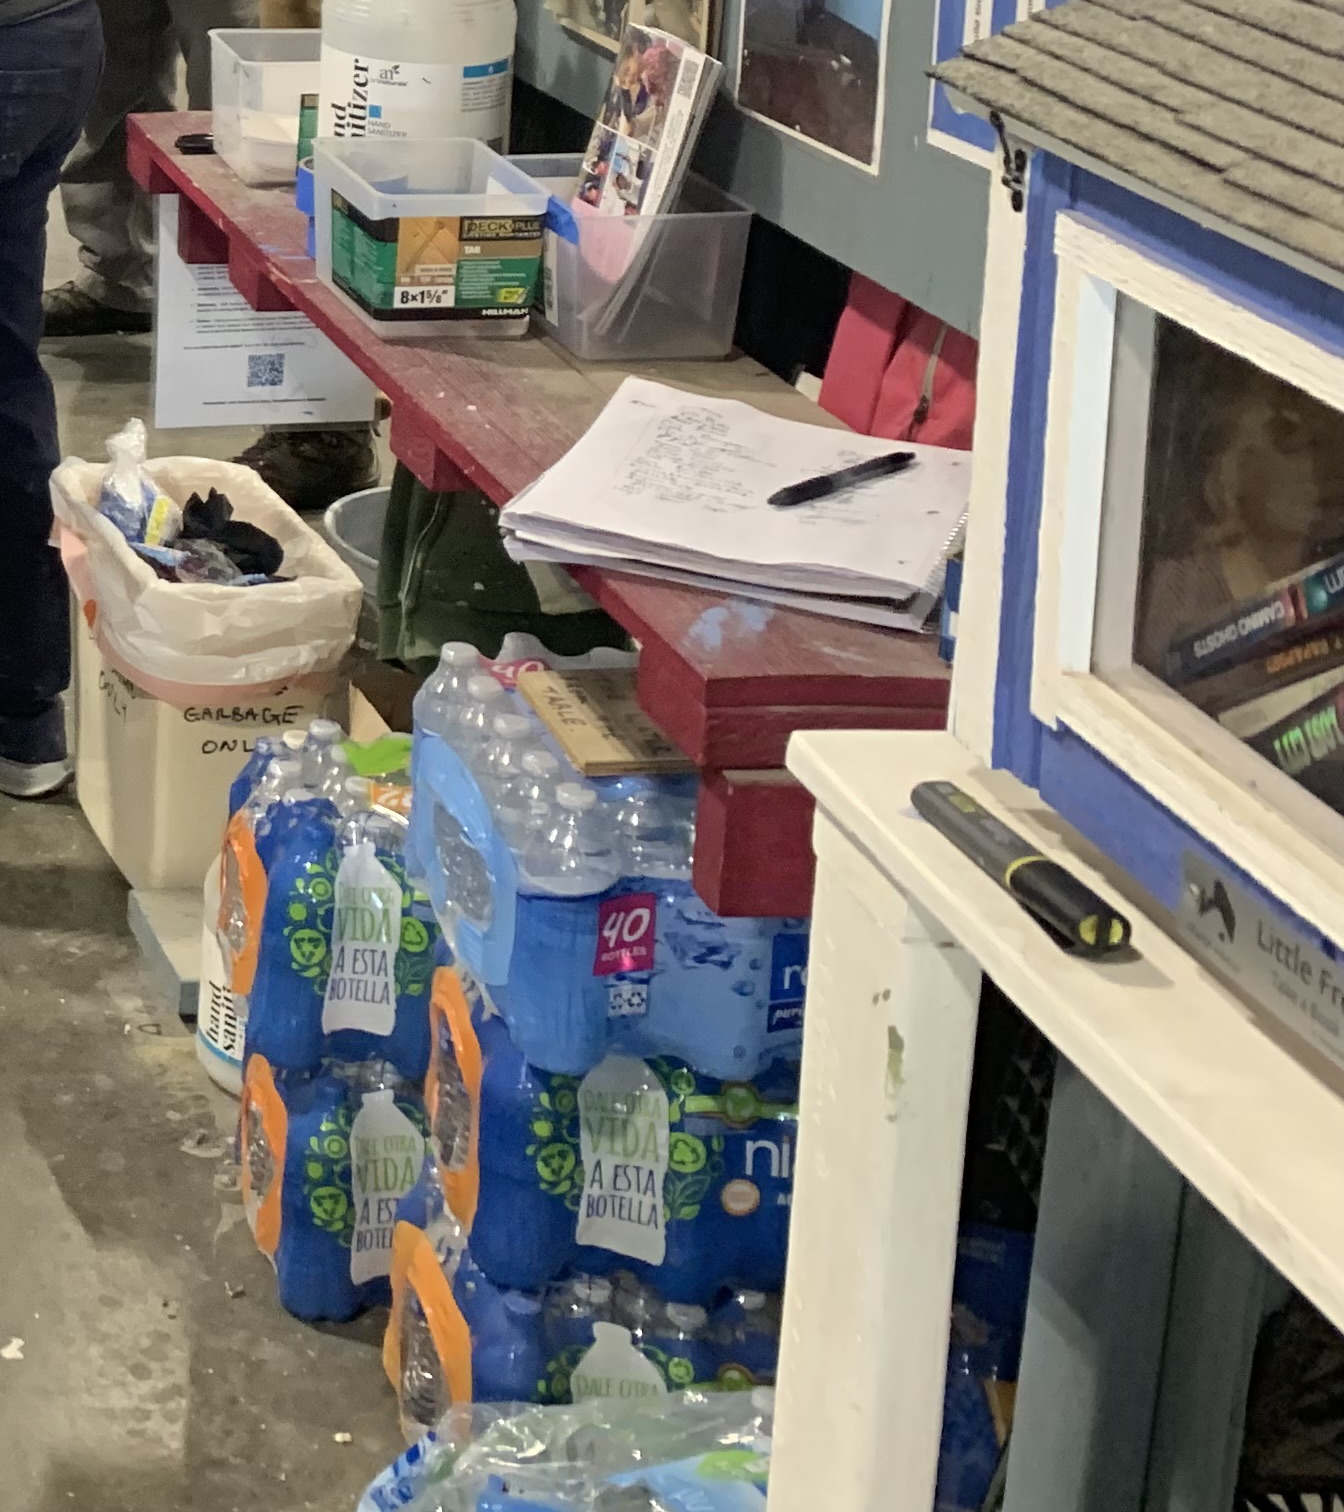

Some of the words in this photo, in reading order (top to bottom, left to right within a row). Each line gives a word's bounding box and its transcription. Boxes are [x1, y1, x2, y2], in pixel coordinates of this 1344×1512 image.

[466, 221, 508, 233] DECK
[464, 246, 481, 255] TAN
[482, 307, 529, 316] HILLMAN
[183, 705, 305, 725] GARBAGE
[201, 739, 255, 755] ONL
[337, 906, 392, 944] VIDA
[602, 907, 651, 949] 40
[334, 945, 345, 969] A
[352, 948, 389, 978] ESTA
[1257, 919, 1312, 986] Little
[328, 978, 391, 1005] BOTELLA
[584, 1116, 659, 1164] VIDA
[356, 1156, 415, 1194] VIDA
[590, 1159, 604, 1190] A
[613, 1164, 656, 1198] ESTA
[359, 1197, 370, 1225] A
[585, 1194, 659, 1230] BOTELLA
